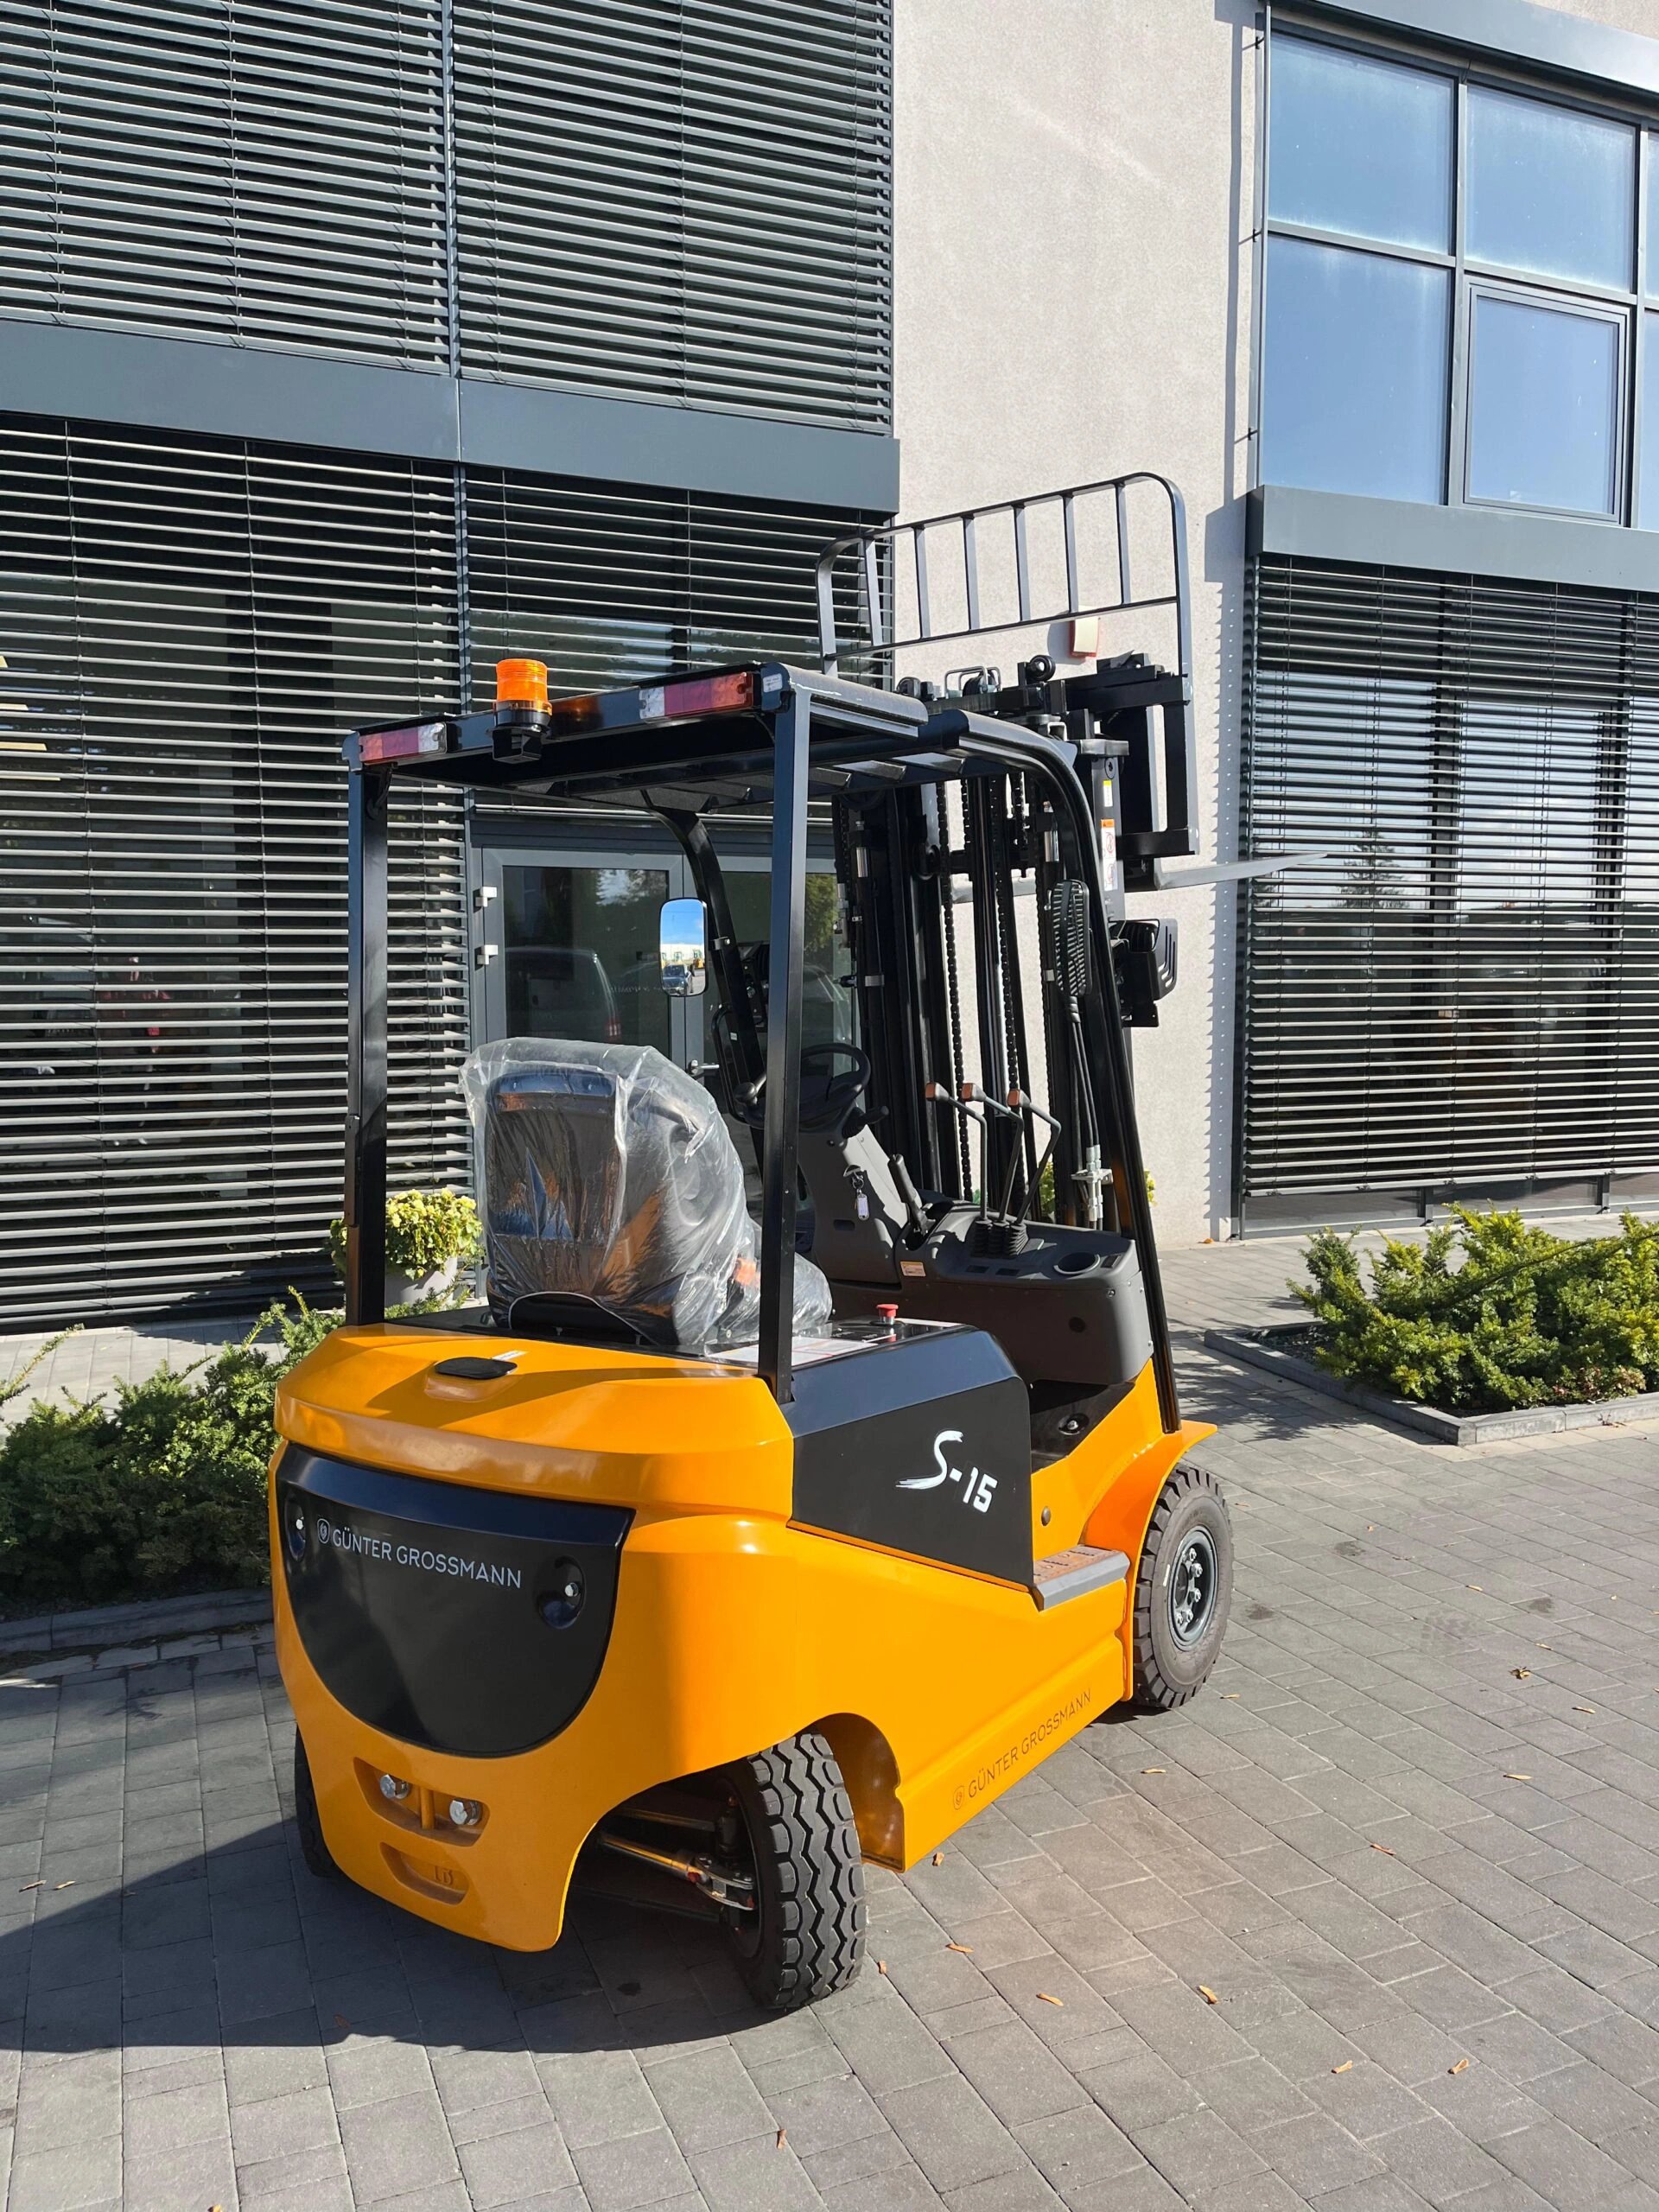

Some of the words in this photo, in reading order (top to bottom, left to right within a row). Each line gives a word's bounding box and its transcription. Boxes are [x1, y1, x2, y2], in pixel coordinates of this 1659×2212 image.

[896, 1430, 998, 1513] S-15
[332, 1527, 391, 1561] GÜNTER
[396, 1545, 522, 1589] GROSSMANN
[968, 1746, 1020, 1798] GÜNTER
[1020, 1688, 1091, 1756] GROSSMANN
